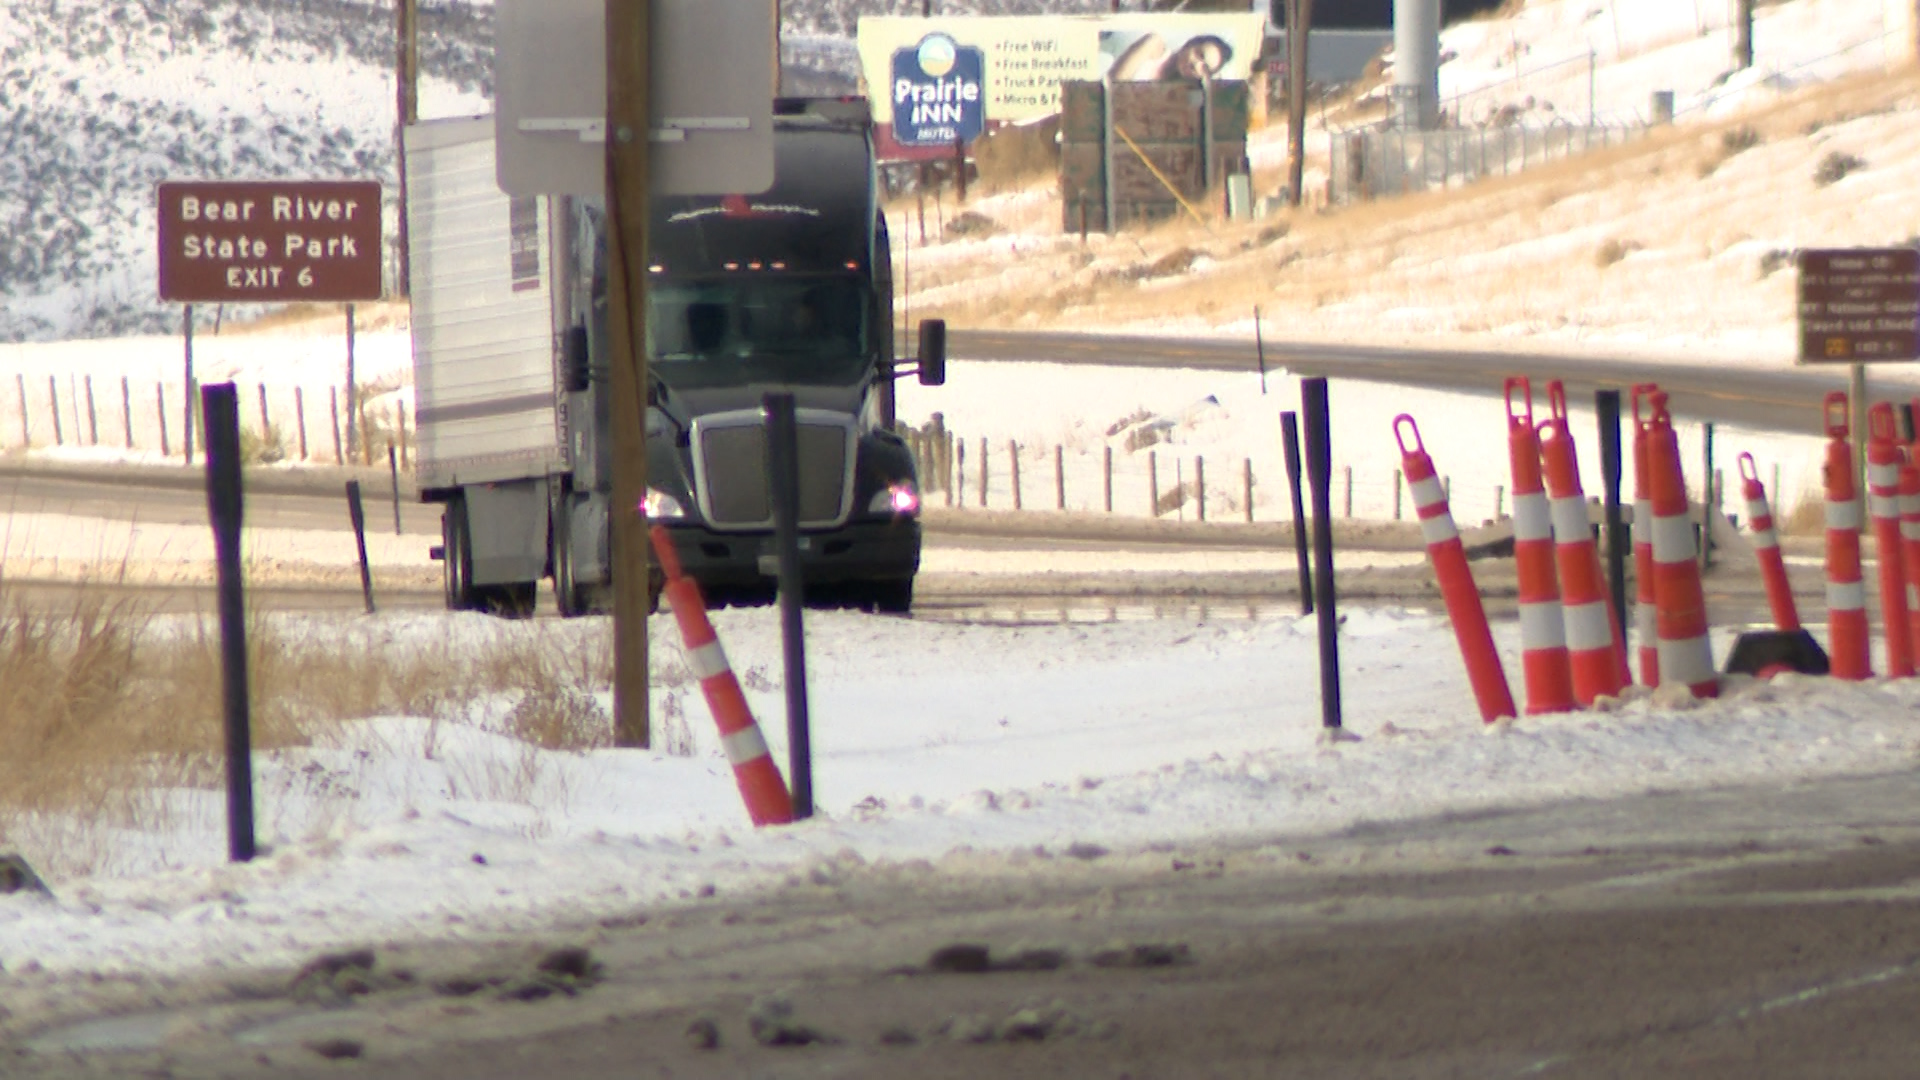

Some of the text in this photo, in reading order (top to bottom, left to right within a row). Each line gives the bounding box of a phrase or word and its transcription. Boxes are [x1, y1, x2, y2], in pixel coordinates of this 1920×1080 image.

[1003, 40, 1028, 52] Free
[1003, 57, 1088, 70] Free Breakfast
[895, 76, 979, 103] Prairie
[1003, 74, 1035, 88] Truck
[1003, 93, 1037, 105] Micro
[1040, 93, 1049, 105] &
[911, 103, 962, 124] INN
[181, 195, 358, 221] Bear River
[183, 234, 358, 259] State Park
[226, 266, 313, 288] EXIT 6
